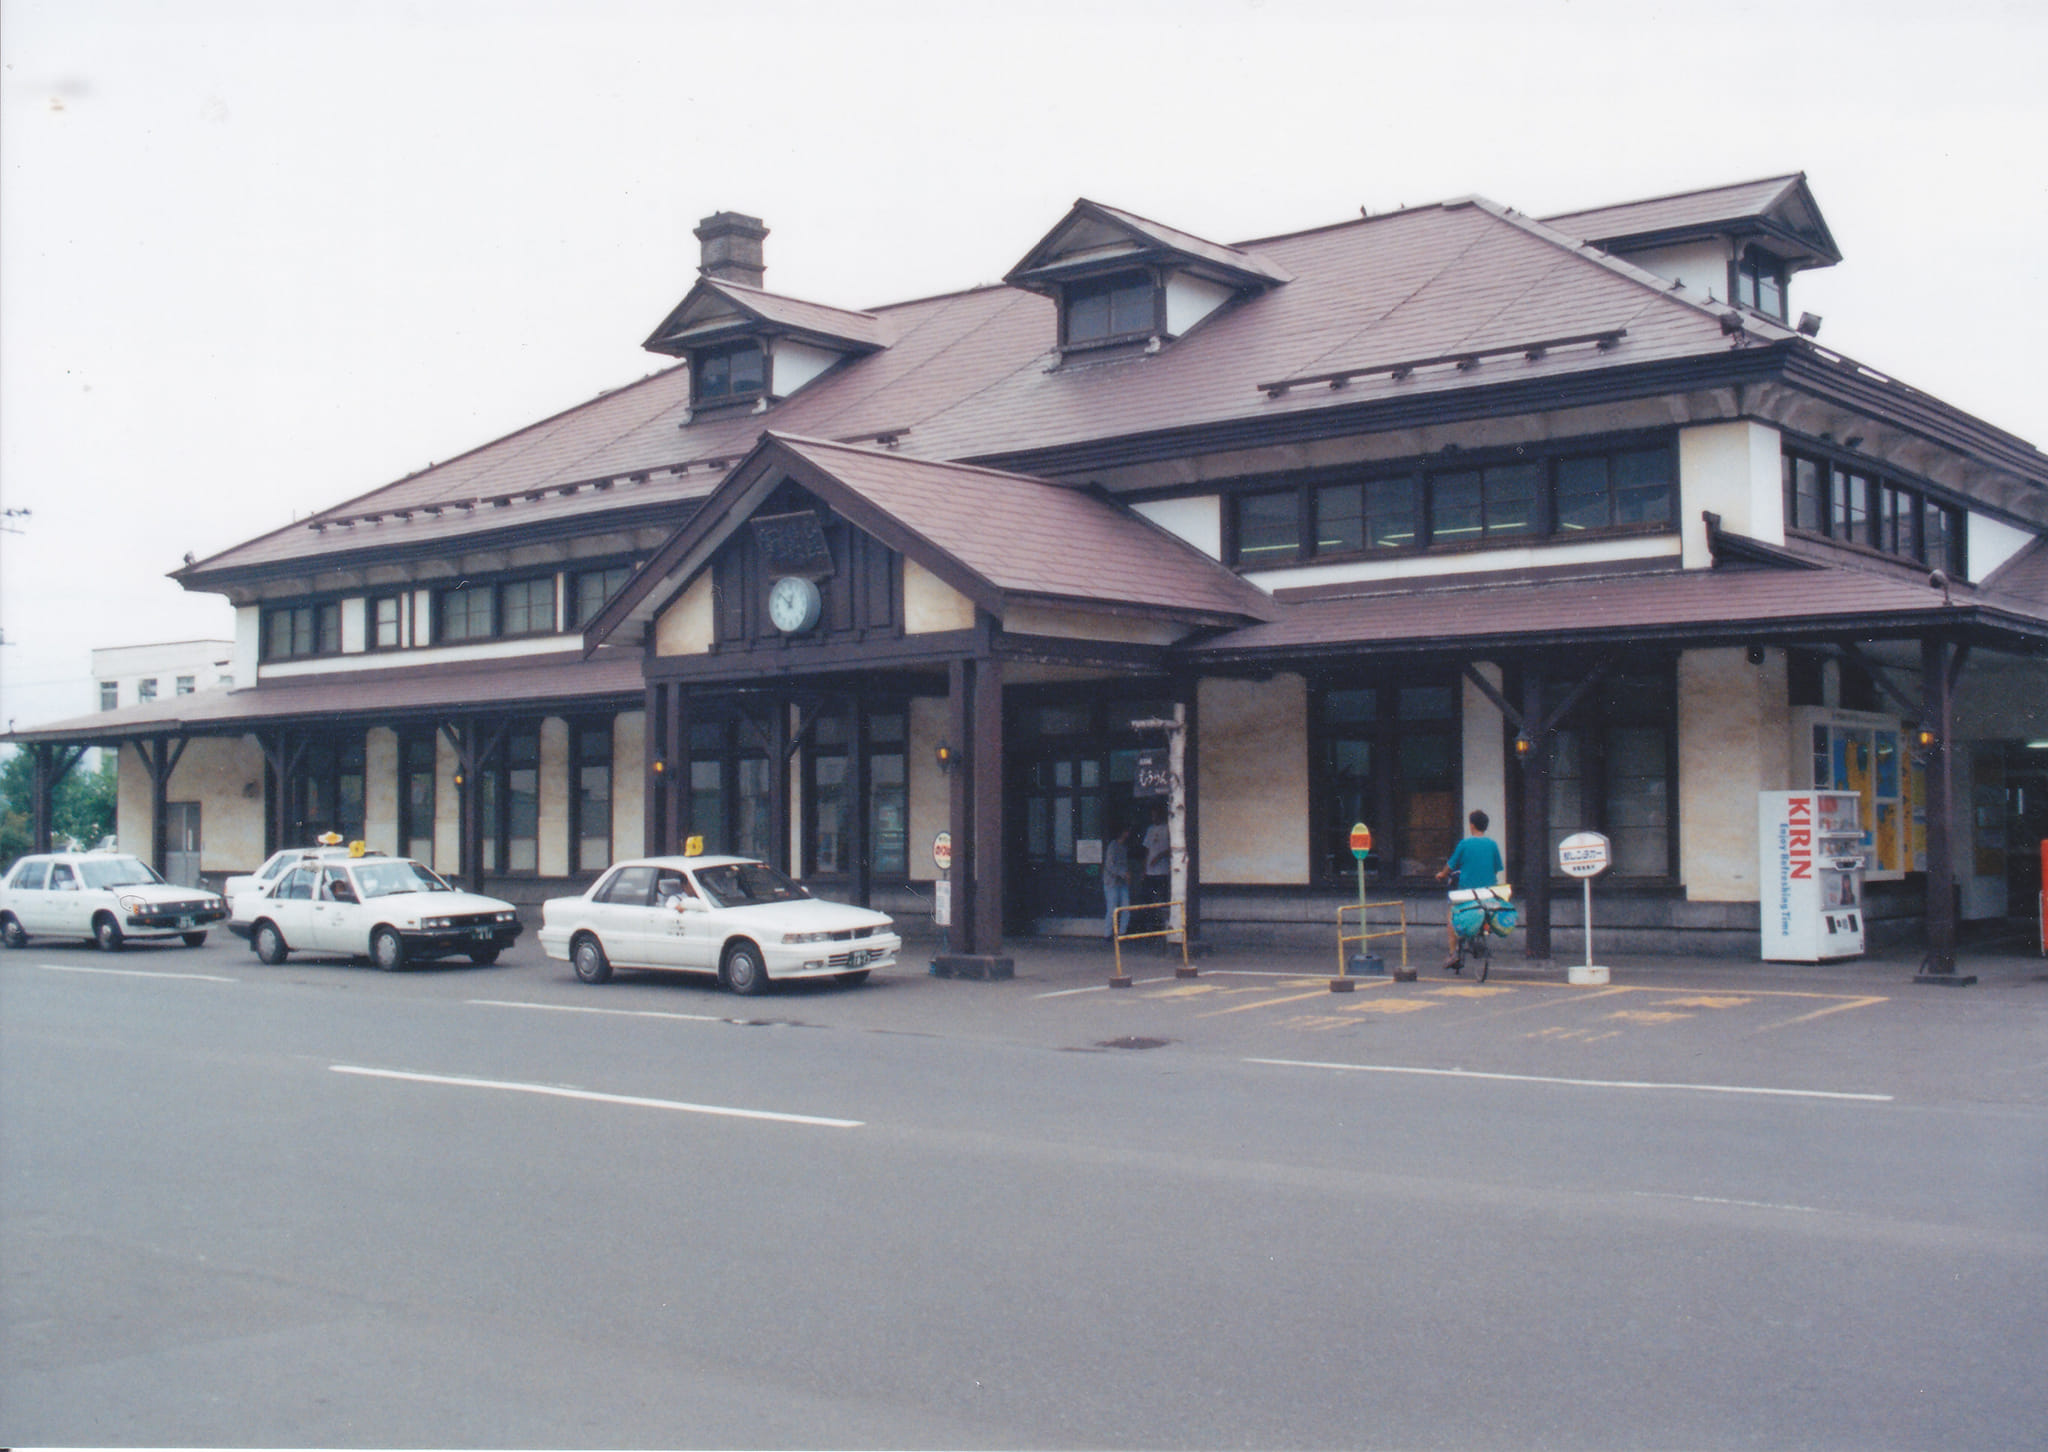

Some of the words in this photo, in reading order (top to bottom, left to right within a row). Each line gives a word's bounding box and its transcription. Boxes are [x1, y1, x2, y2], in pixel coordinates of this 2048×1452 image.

[1779, 823, 1788, 851] Enjoy
[1788, 798, 1811, 879] KIRIN
[1779, 854, 1790, 910] Refreshing
[1781, 912, 1791, 936] Time
